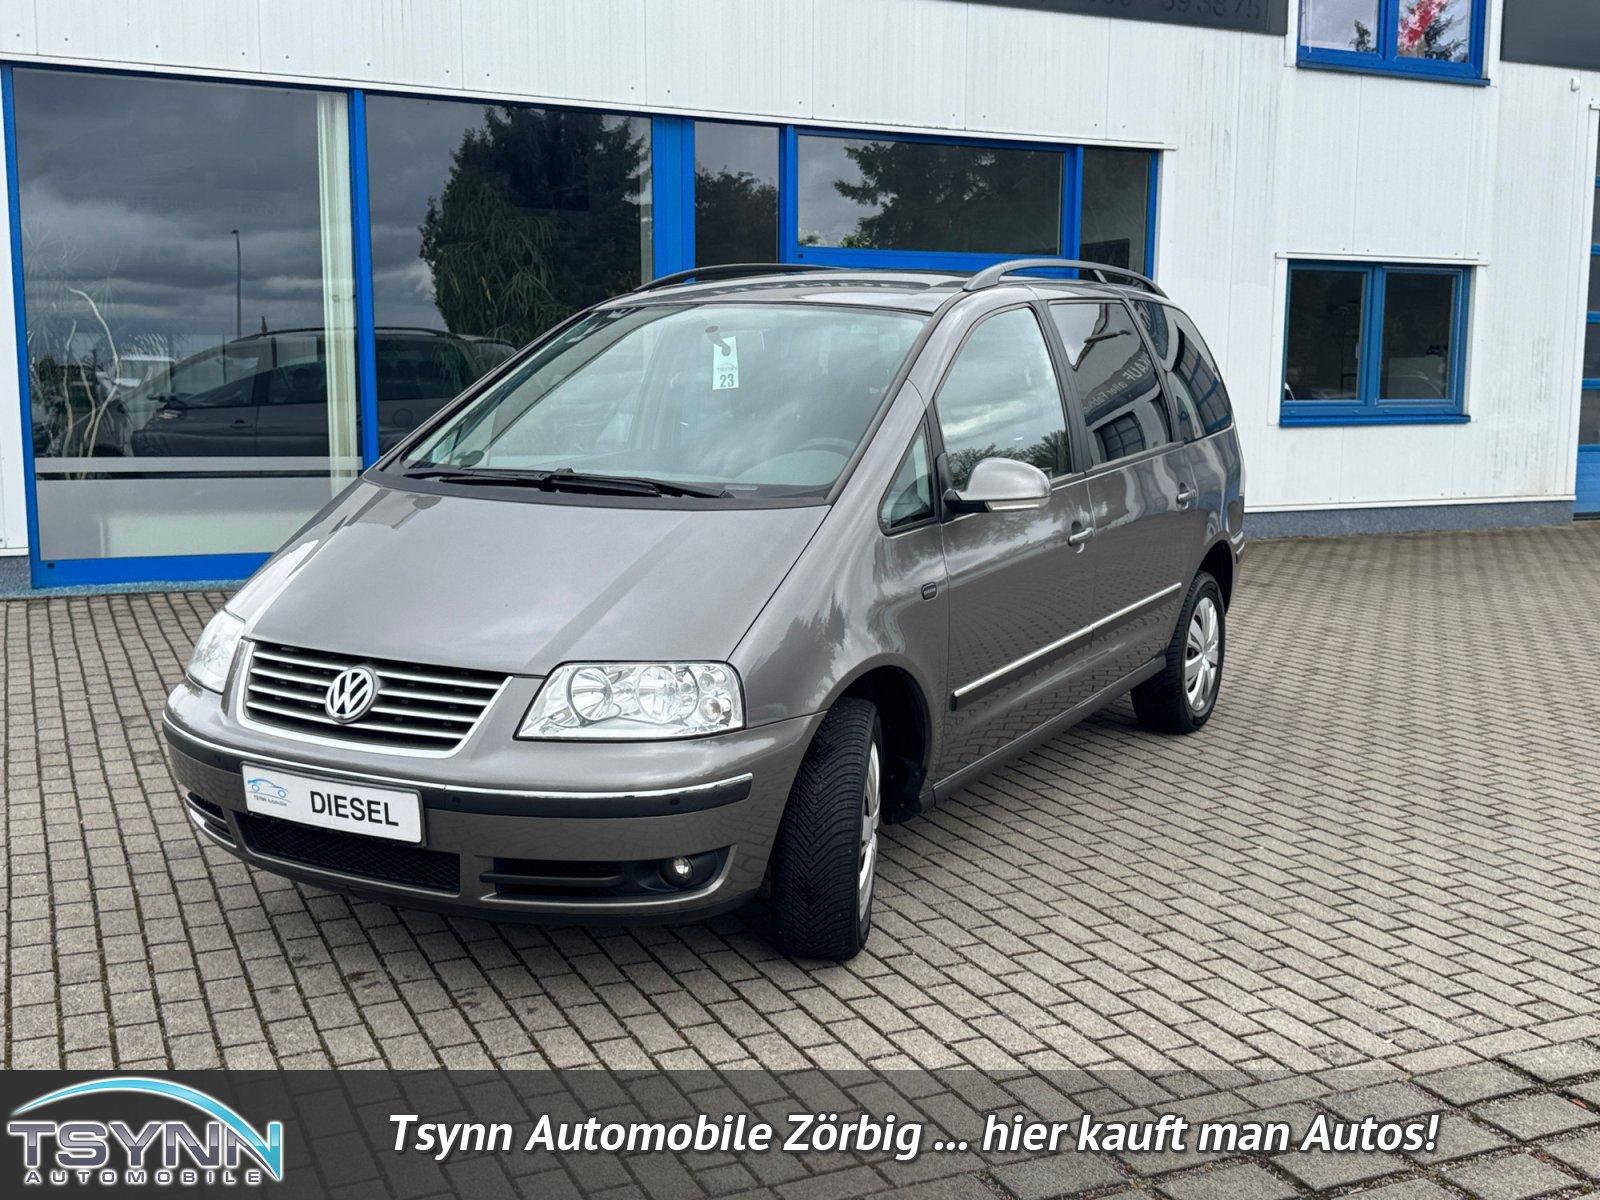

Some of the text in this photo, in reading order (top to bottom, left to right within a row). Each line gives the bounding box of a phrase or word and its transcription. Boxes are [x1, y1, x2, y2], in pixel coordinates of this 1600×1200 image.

[720, 373, 735, 388] 23
[326, 667, 374, 720] VW
[310, 791, 399, 826] DIESEL
